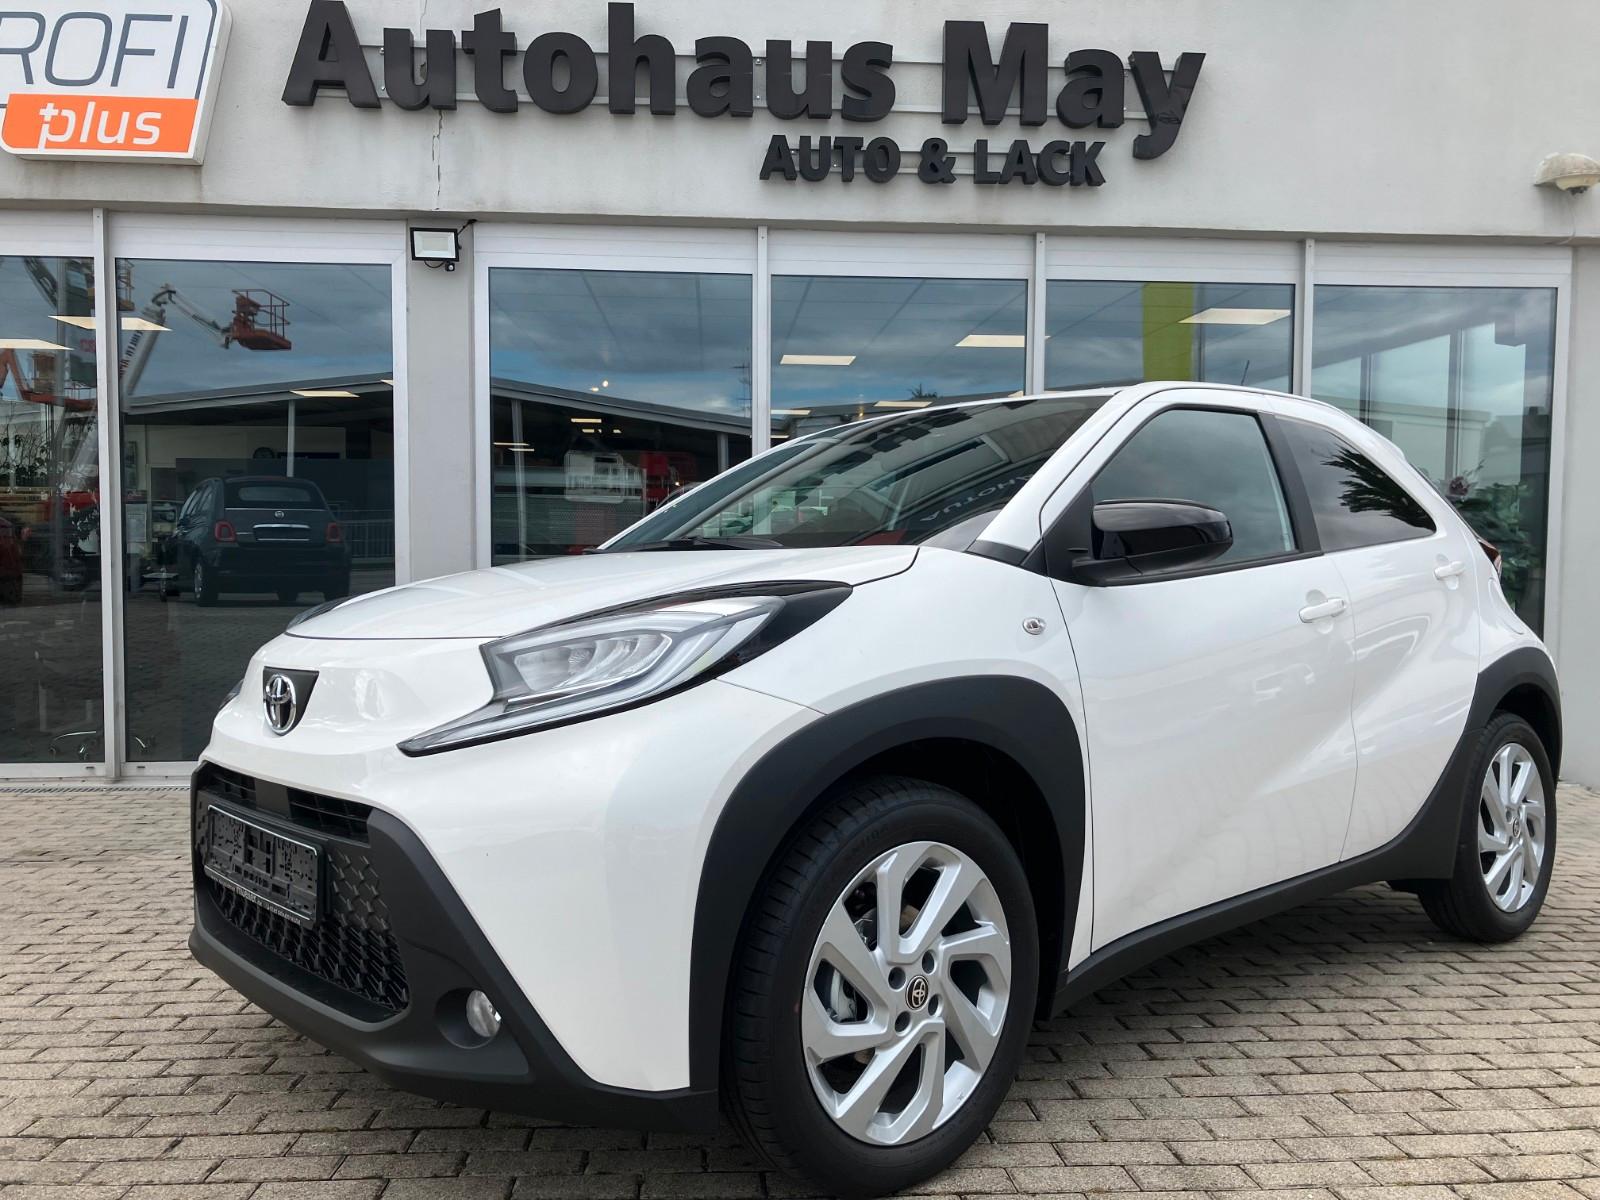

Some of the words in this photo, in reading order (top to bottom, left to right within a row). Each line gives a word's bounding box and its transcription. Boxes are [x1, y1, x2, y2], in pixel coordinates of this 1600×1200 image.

[0, 11, 189, 89] ROFI
[282, 0, 896, 122] Autohaus
[942, 20, 1206, 161] May
[759, 135, 901, 183] AUTO
[917, 137, 957, 184] &
[973, 139, 1107, 187] LACK
